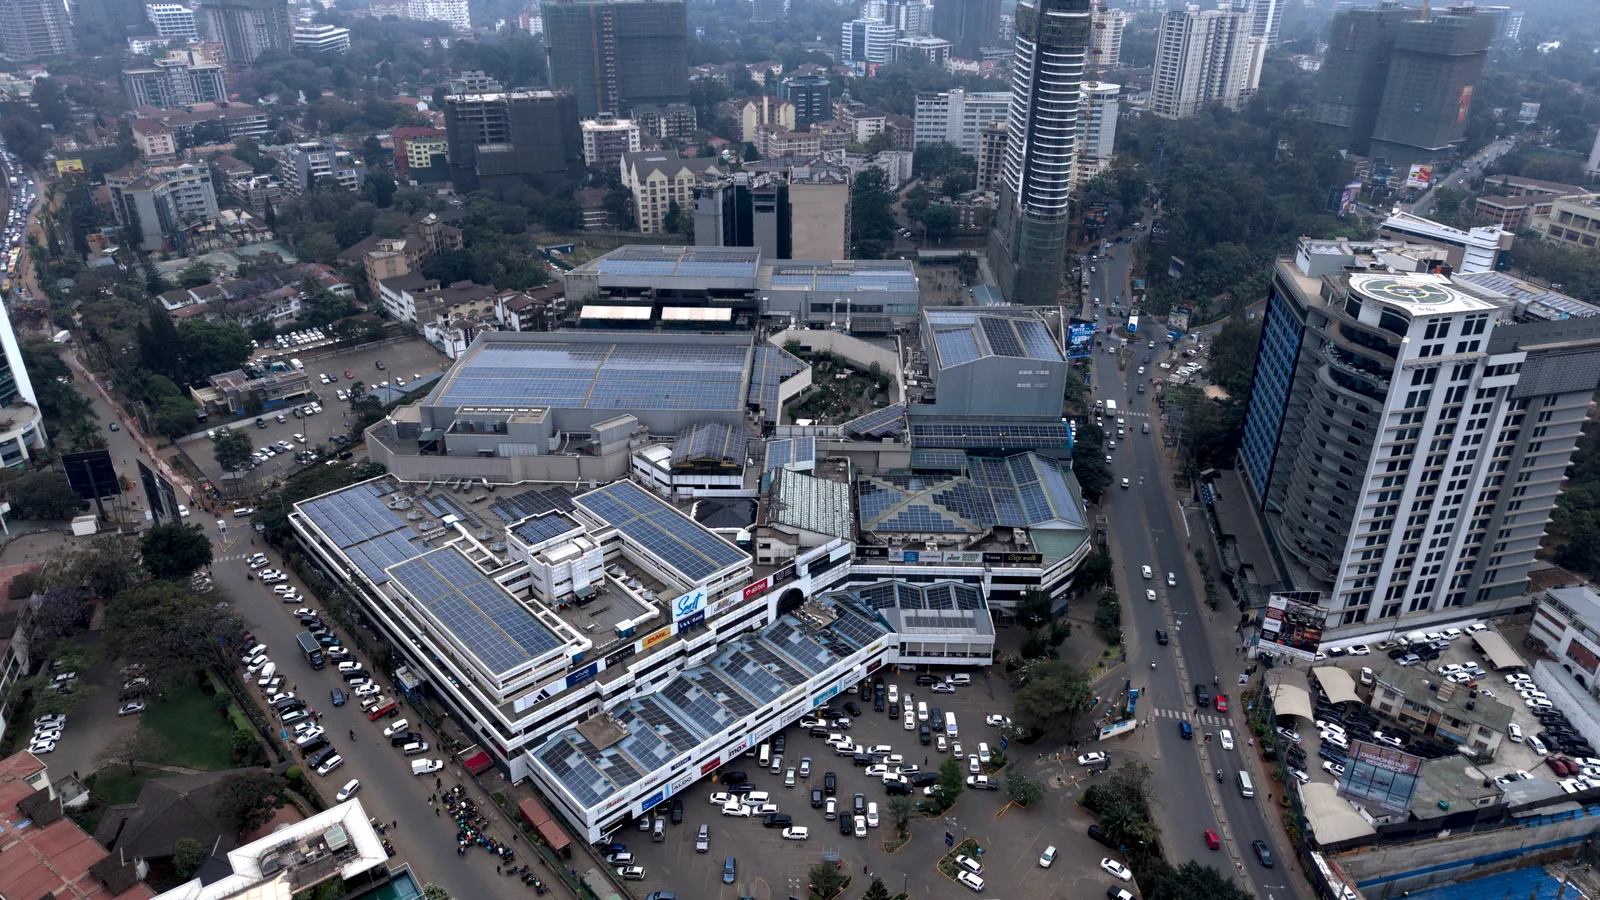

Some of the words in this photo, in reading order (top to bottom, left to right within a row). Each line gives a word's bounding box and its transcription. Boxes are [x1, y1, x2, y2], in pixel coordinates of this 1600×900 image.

[751, 583, 766, 594] airtel
[729, 742, 747, 757] max
[1361, 752, 1395, 766] DIAMOND
[1395, 761, 1411, 770] BAY
[1365, 758, 1403, 773] RESIDENCE
[674, 776, 693, 789] ALDO
